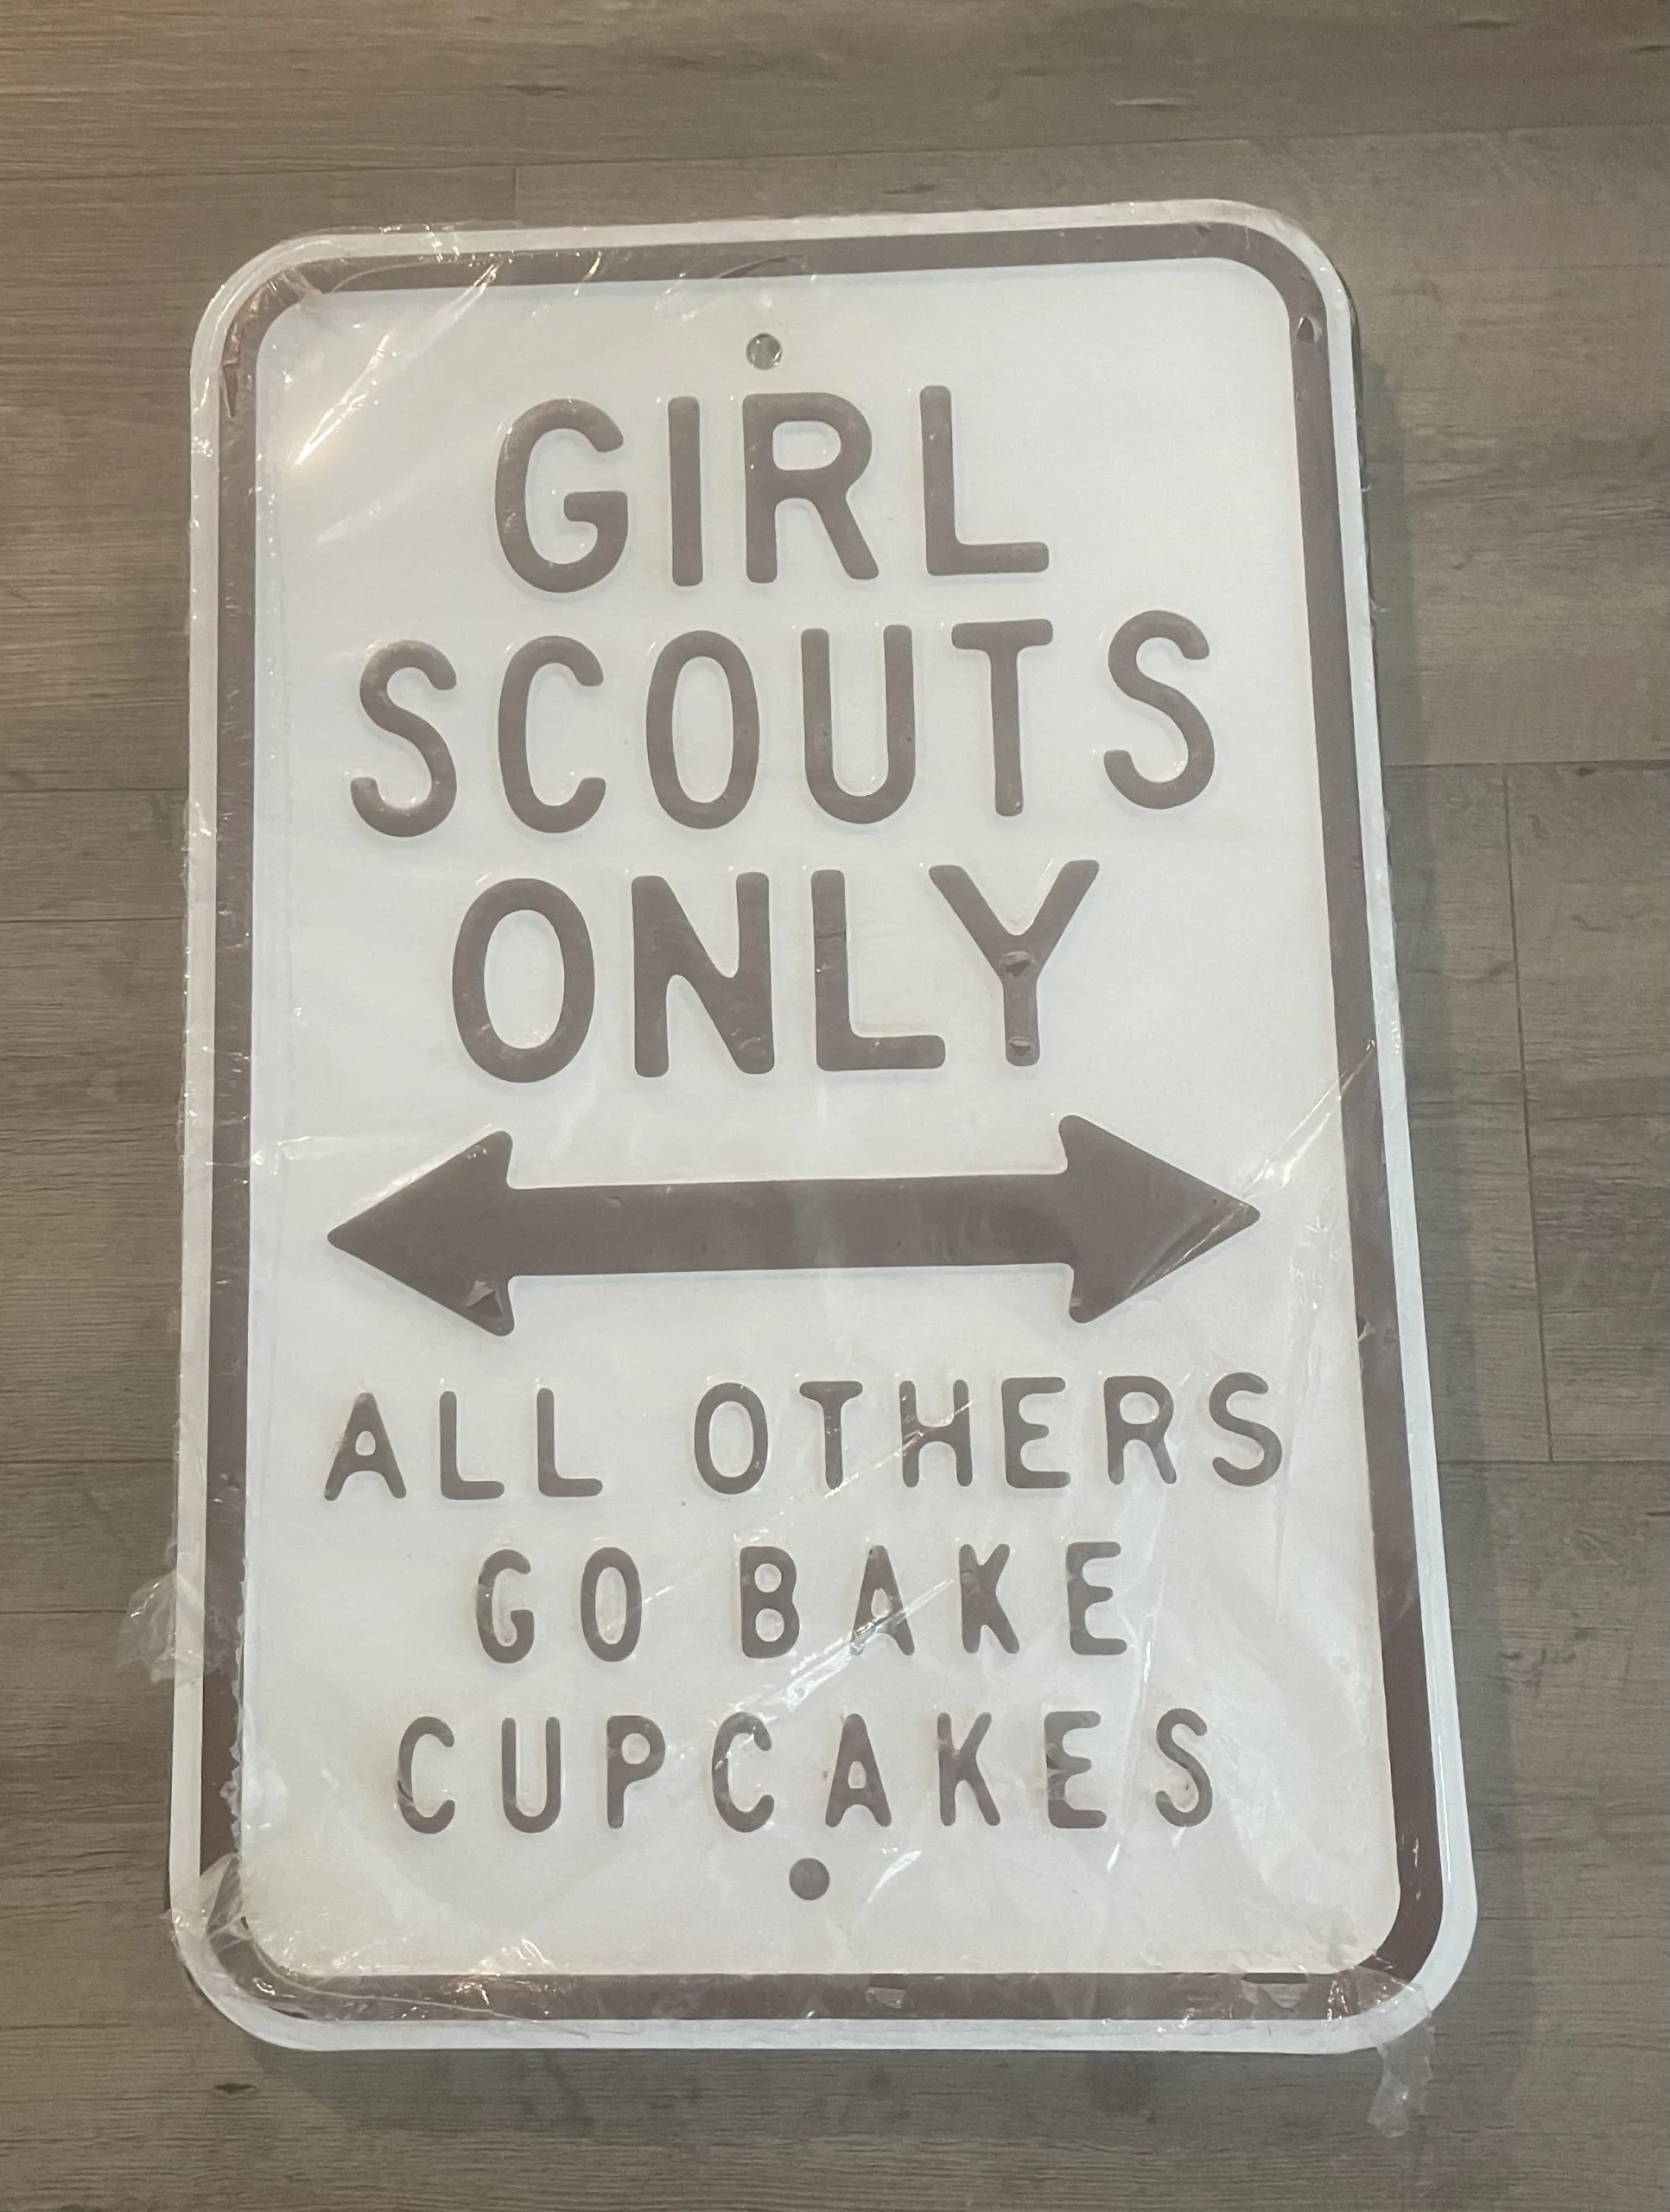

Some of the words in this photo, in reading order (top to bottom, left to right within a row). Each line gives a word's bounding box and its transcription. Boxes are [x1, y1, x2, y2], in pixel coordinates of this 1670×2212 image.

[494, 385, 1050, 594] GIRL
[350, 610, 1215, 838] SCOUTS
[452, 860, 1099, 1084] ONLY
[324, 1391, 603, 1502] ALL
[693, 1371, 1284, 1495] OTHERS
[475, 1546, 642, 1664] GO
[740, 1541, 1127, 1660] BAKE
[397, 1707, 1214, 1834] CUPCAKES
